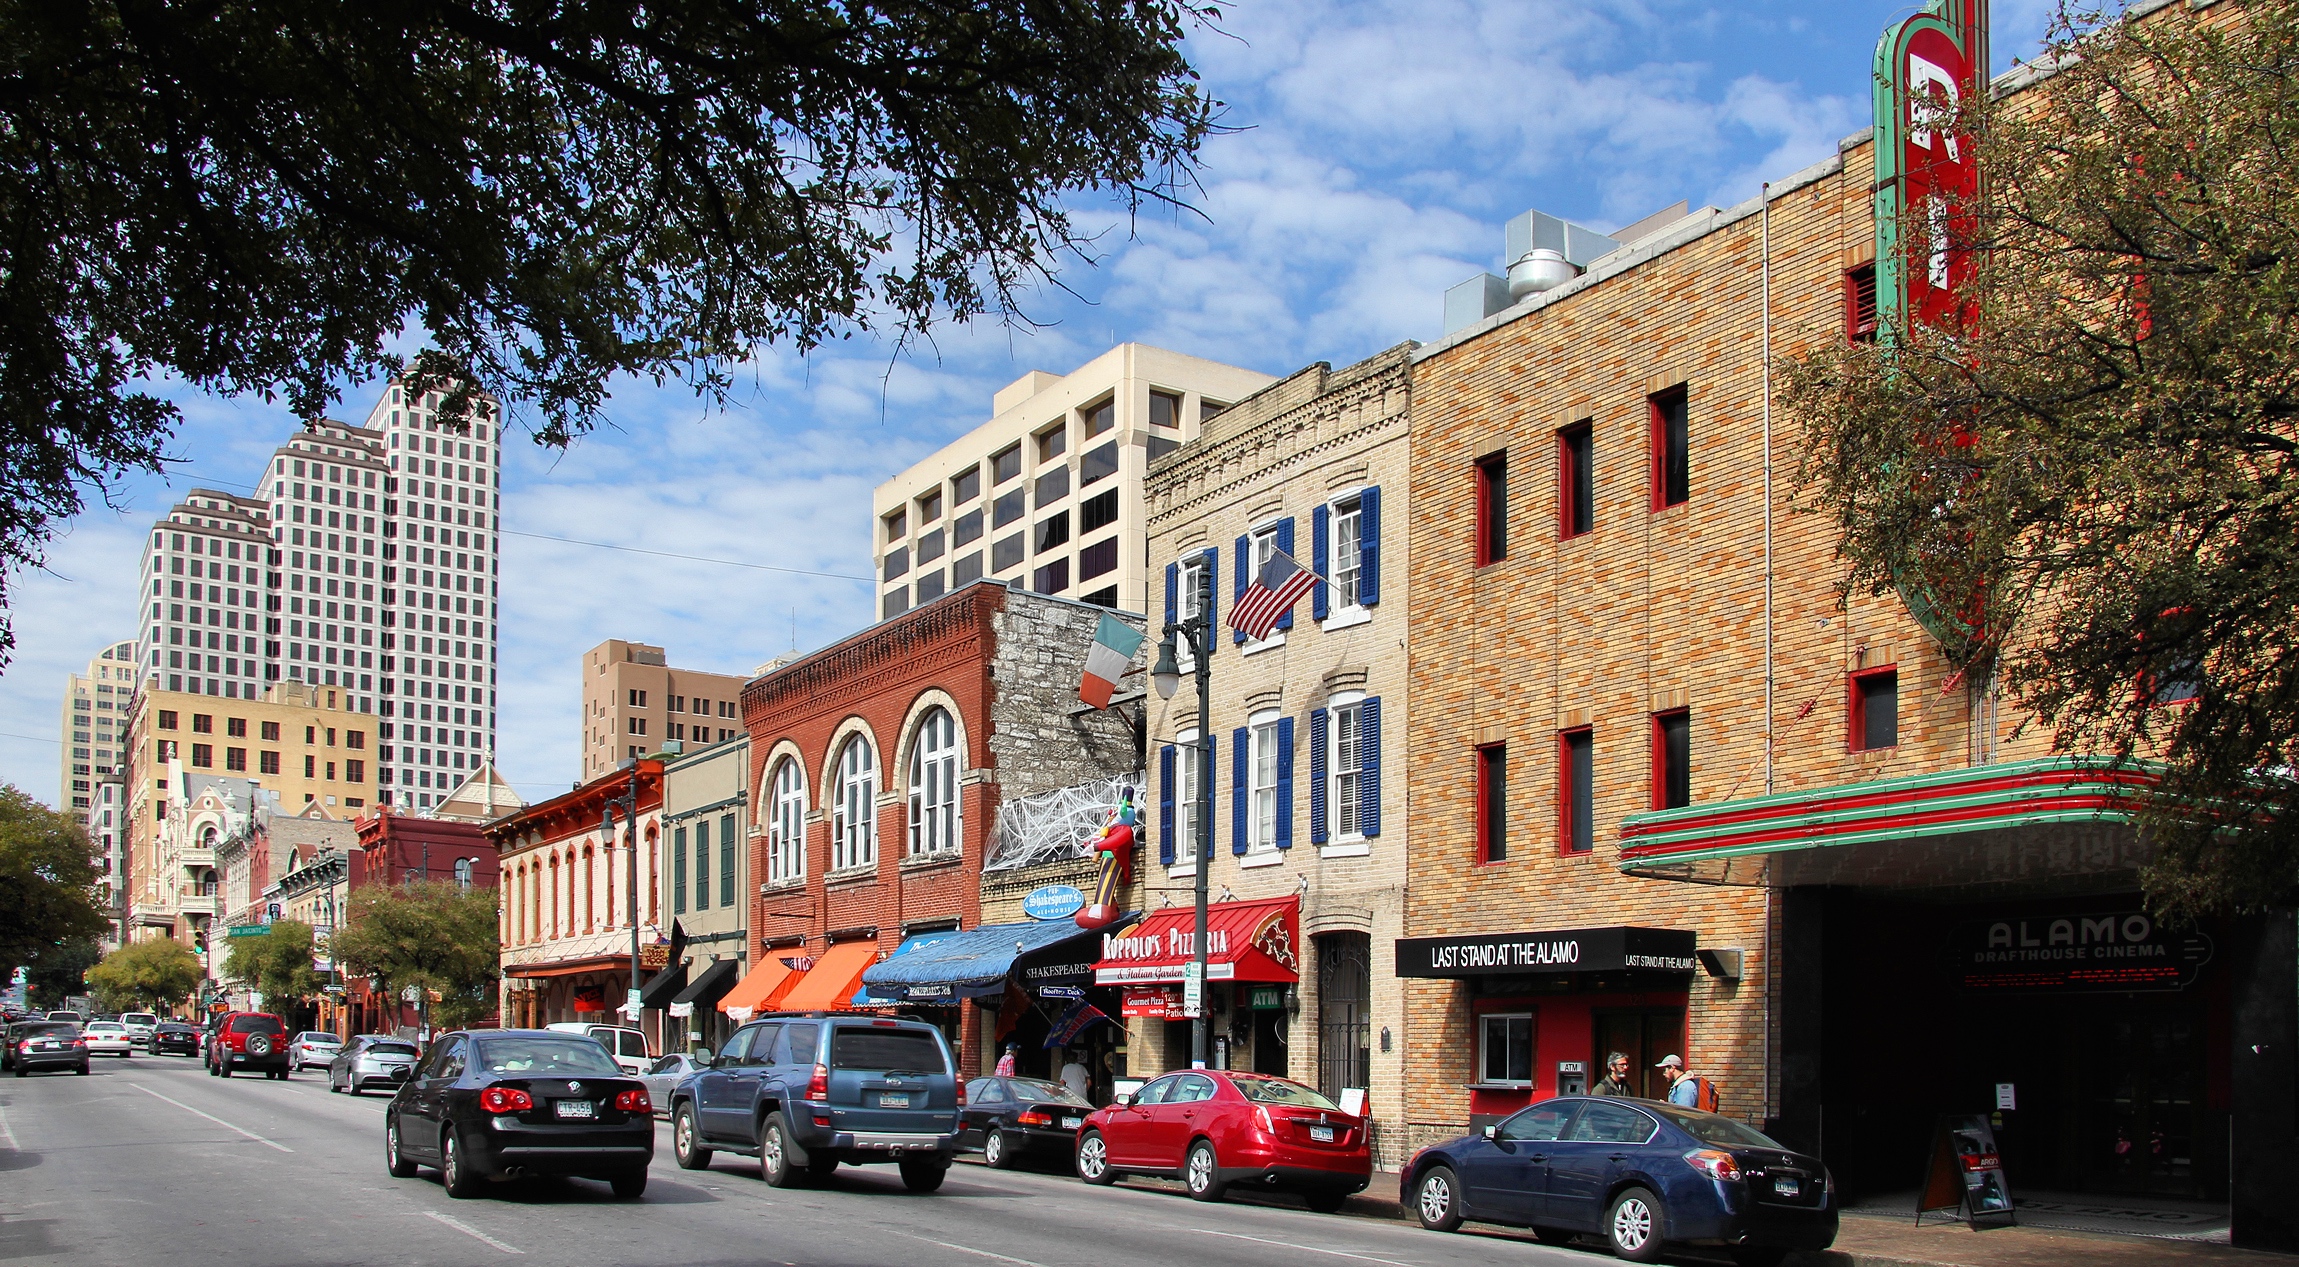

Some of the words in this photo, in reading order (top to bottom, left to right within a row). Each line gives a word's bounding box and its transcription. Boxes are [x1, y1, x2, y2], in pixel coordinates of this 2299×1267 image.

[1029, 891, 1079, 908] Shakespeare's
[1988, 915, 2151, 948] ALAMO
[1170, 928, 1227, 955] PIZZRIA
[1432, 946, 1459, 968] LAST
[1461, 944, 1495, 967] STAND
[1497, 944, 1510, 966] AT
[1512, 943, 1535, 965] THE
[1536, 941, 1579, 964] ALAMO
[1625, 954, 1640, 967] LAST
[1640, 955, 1658, 968] STAND
[1658, 956, 1664, 968] AT
[1665, 956, 1676, 969] THE
[1676, 957, 1695, 969] ALAMO
[1974, 947, 2086, 964] DRAFTHOUSE
[2093, 944, 2166, 958] CINEMA
[1026, 963, 1091, 978] SHAKESPEARE'S
[1126, 969, 1153, 979] Italian
[1155, 968, 1183, 981] Garden
[1186, 963, 1190, 975] 2
[1127, 997, 1150, 1006] Gourmet
[1150, 997, 1164, 1005] Pizza
[1253, 992, 1278, 1006] ATM
[1165, 1009, 1183, 1017] Patio
[1980, 1158, 1998, 1166] ARGO
